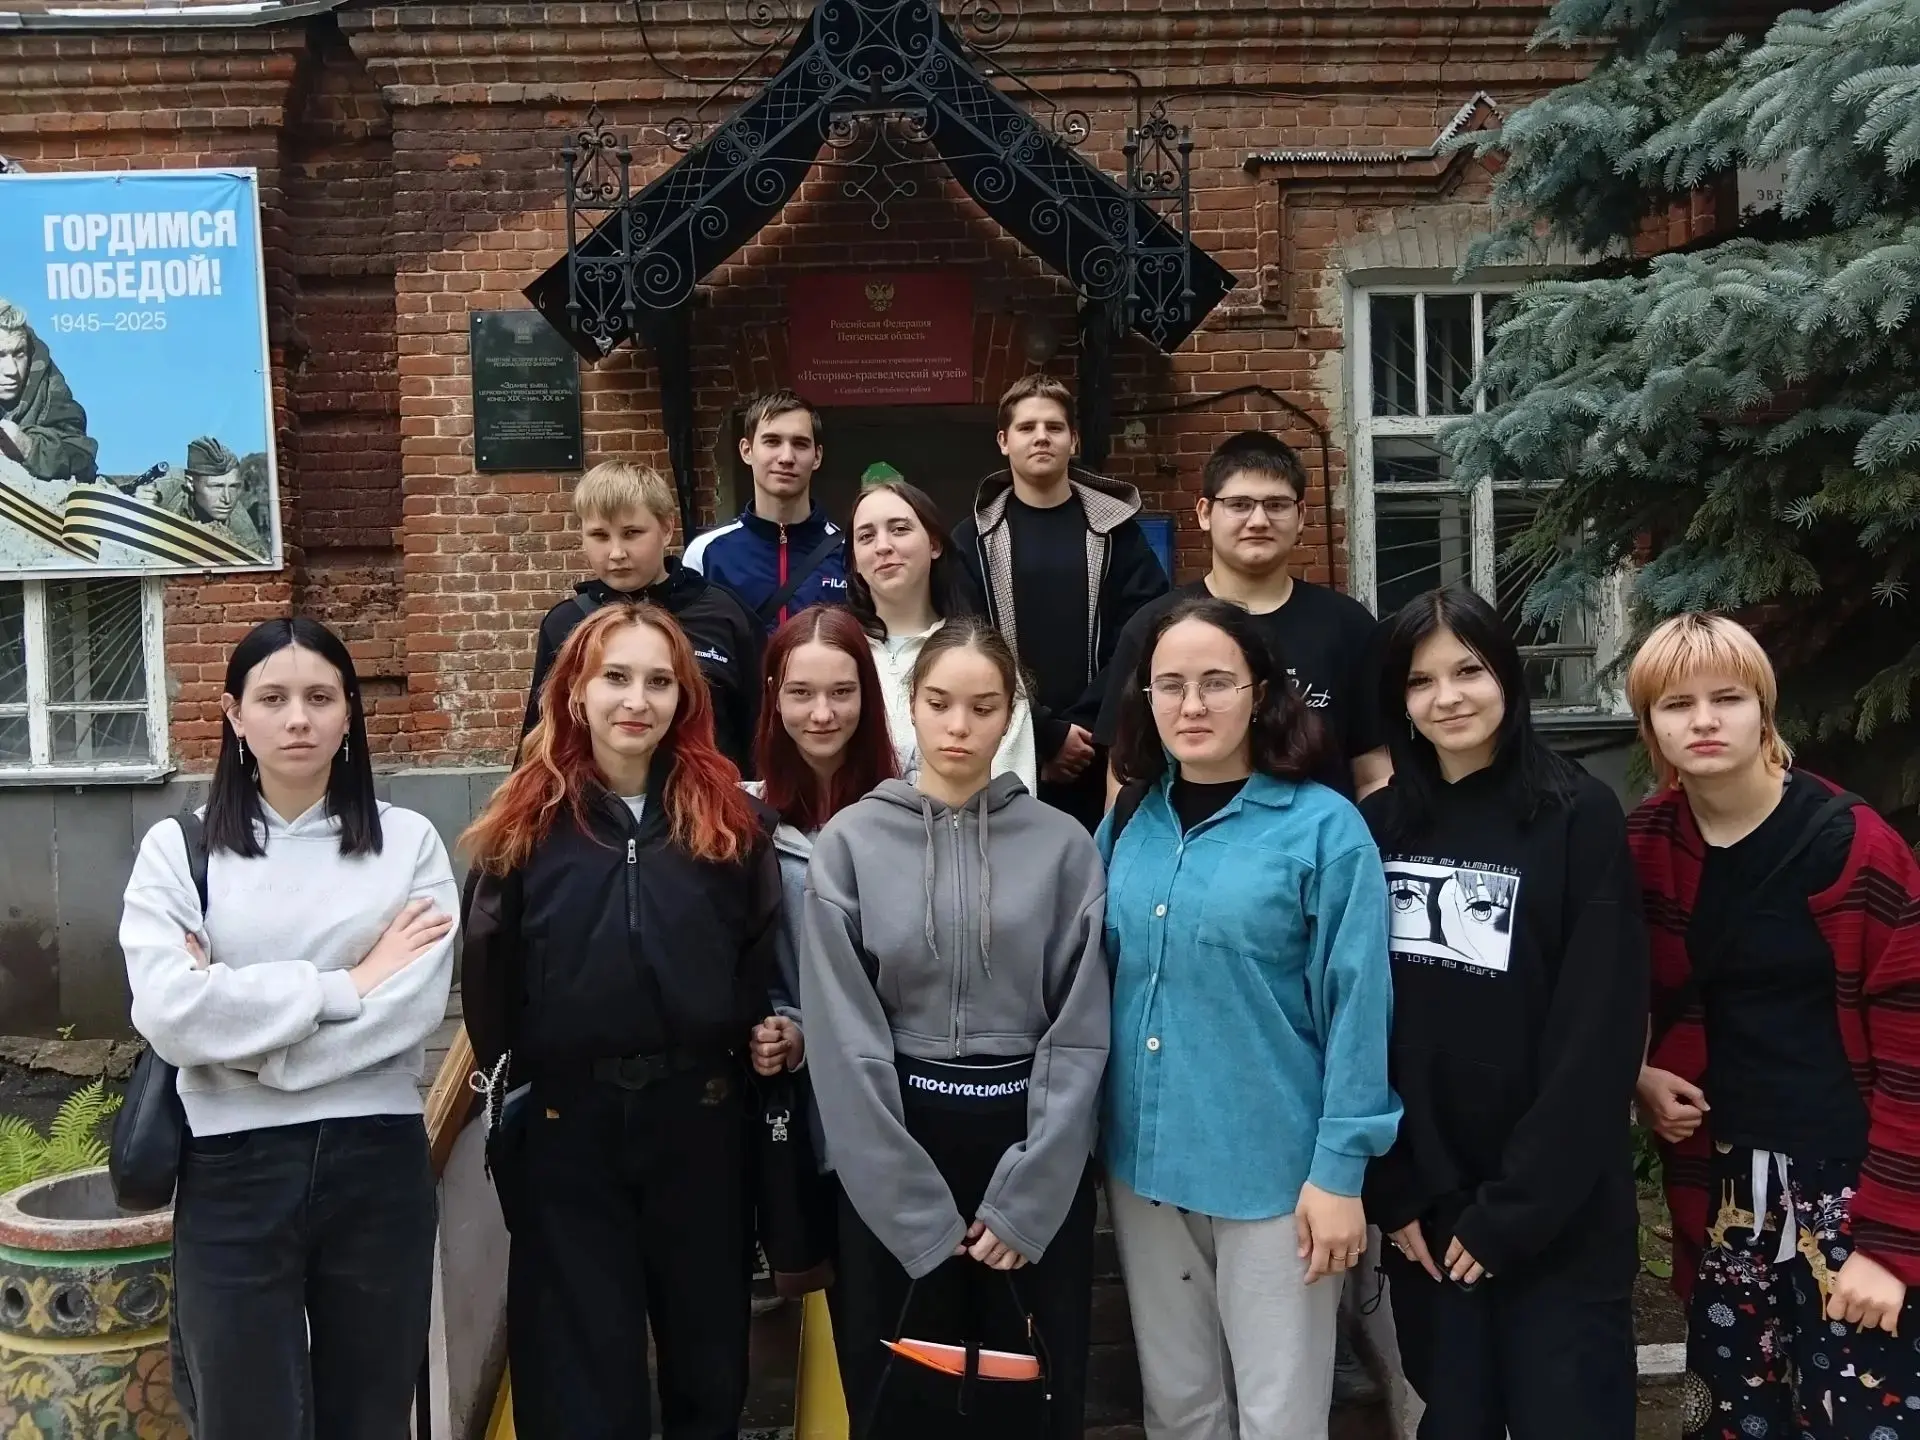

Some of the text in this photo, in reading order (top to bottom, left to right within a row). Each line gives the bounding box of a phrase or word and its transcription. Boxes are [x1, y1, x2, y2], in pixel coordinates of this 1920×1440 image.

[44, 209, 238, 257] ГОРДИМСЯ
[46, 254, 222, 304] ПОБЕДОЙ!
[830, 318, 932, 330] Российская Федерация
[837, 330, 926, 342] Пензенская область
[931, 367, 967, 381] музей»
[822, 576, 848, 589] FILA
[1440, 857, 1456, 866] my
[1442, 959, 1457, 969] my
